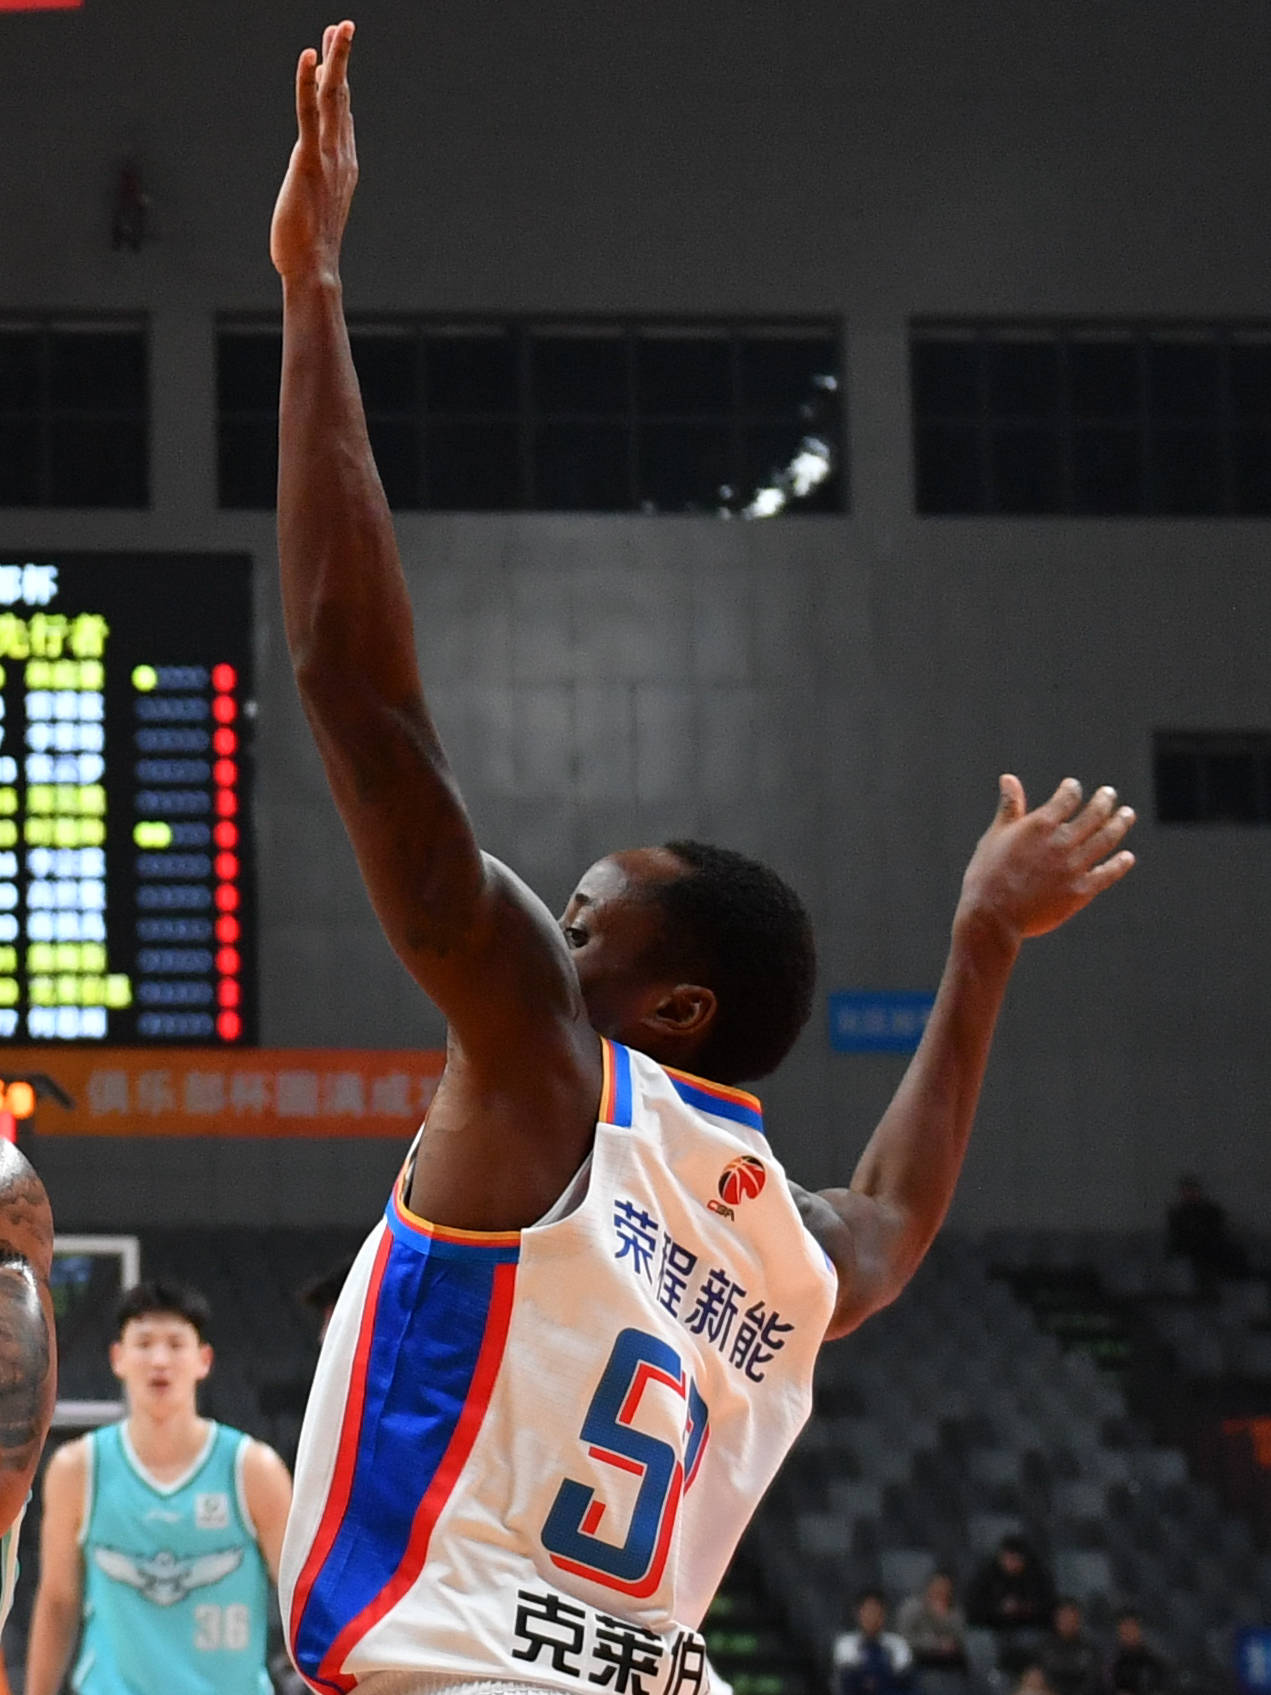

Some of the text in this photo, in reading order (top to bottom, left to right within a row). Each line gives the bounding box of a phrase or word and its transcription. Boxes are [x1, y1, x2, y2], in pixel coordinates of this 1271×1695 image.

[614, 1199, 795, 1384] 荣程新能
[195, 1604, 249, 1651] 36
